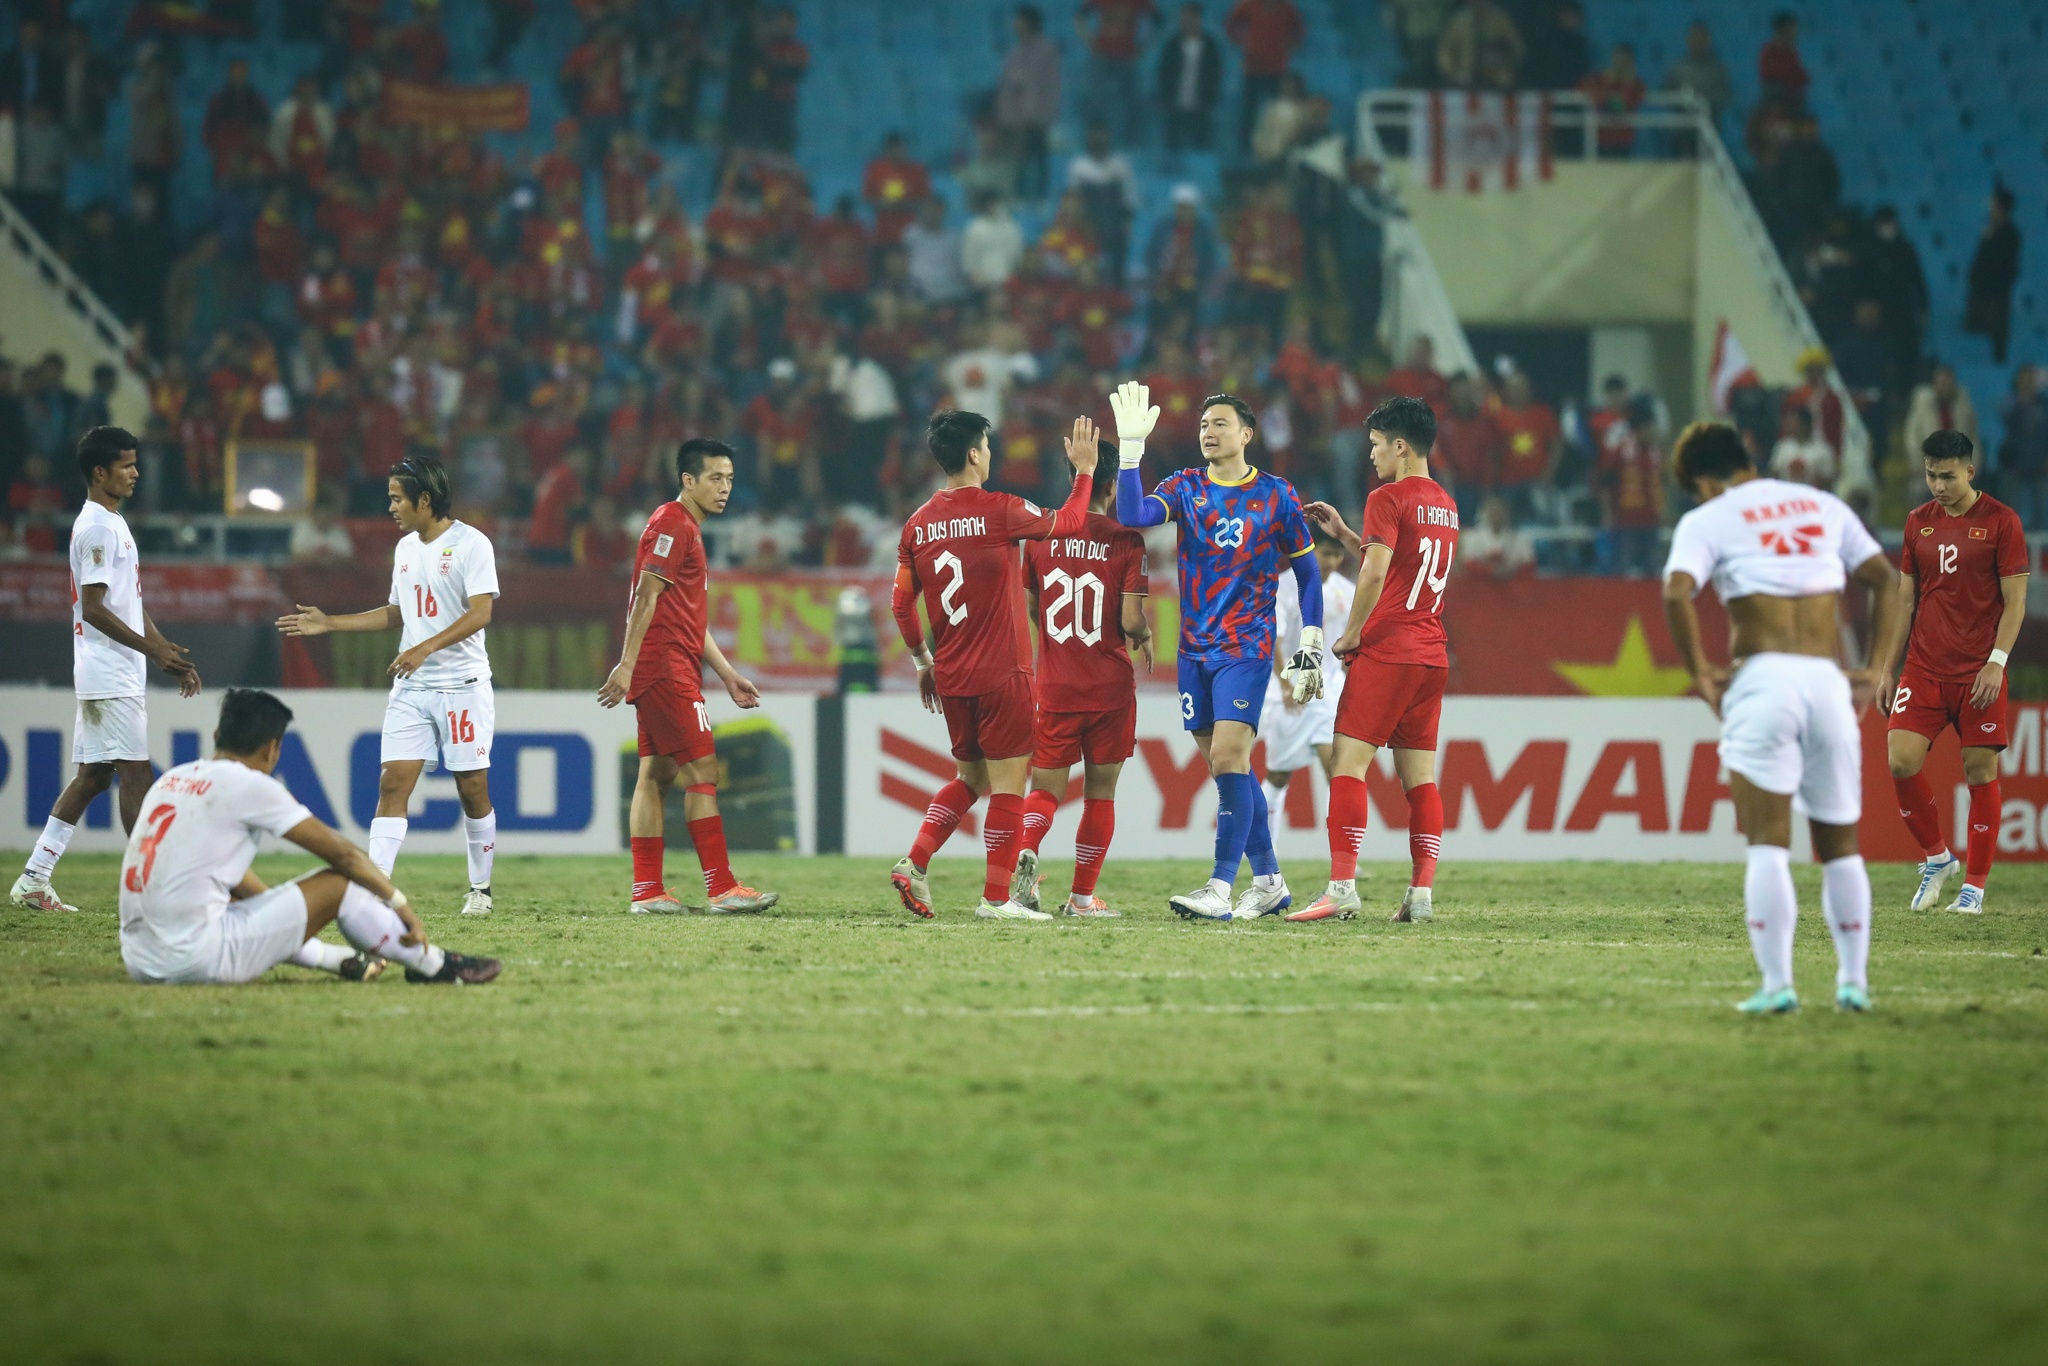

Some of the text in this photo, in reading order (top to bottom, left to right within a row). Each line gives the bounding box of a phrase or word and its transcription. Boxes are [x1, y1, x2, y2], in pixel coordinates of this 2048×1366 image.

[915, 516, 987, 545] D. DUY MANH
[1427, 505, 1449, 527] HOANG
[1214, 517, 1245, 549] 23
[1050, 538, 1110, 562] P. VAN DUC
[1938, 543, 1959, 575] 12
[934, 550, 968, 627] 2
[1405, 536, 1453, 614] 14
[414, 584, 438, 618] 16
[1043, 567, 1104, 647] 20
[1178, 691, 1195, 720] 3
[1891, 687, 1912, 715] 12
[448, 709, 475, 744] 16
[125, 803, 177, 893] 3
